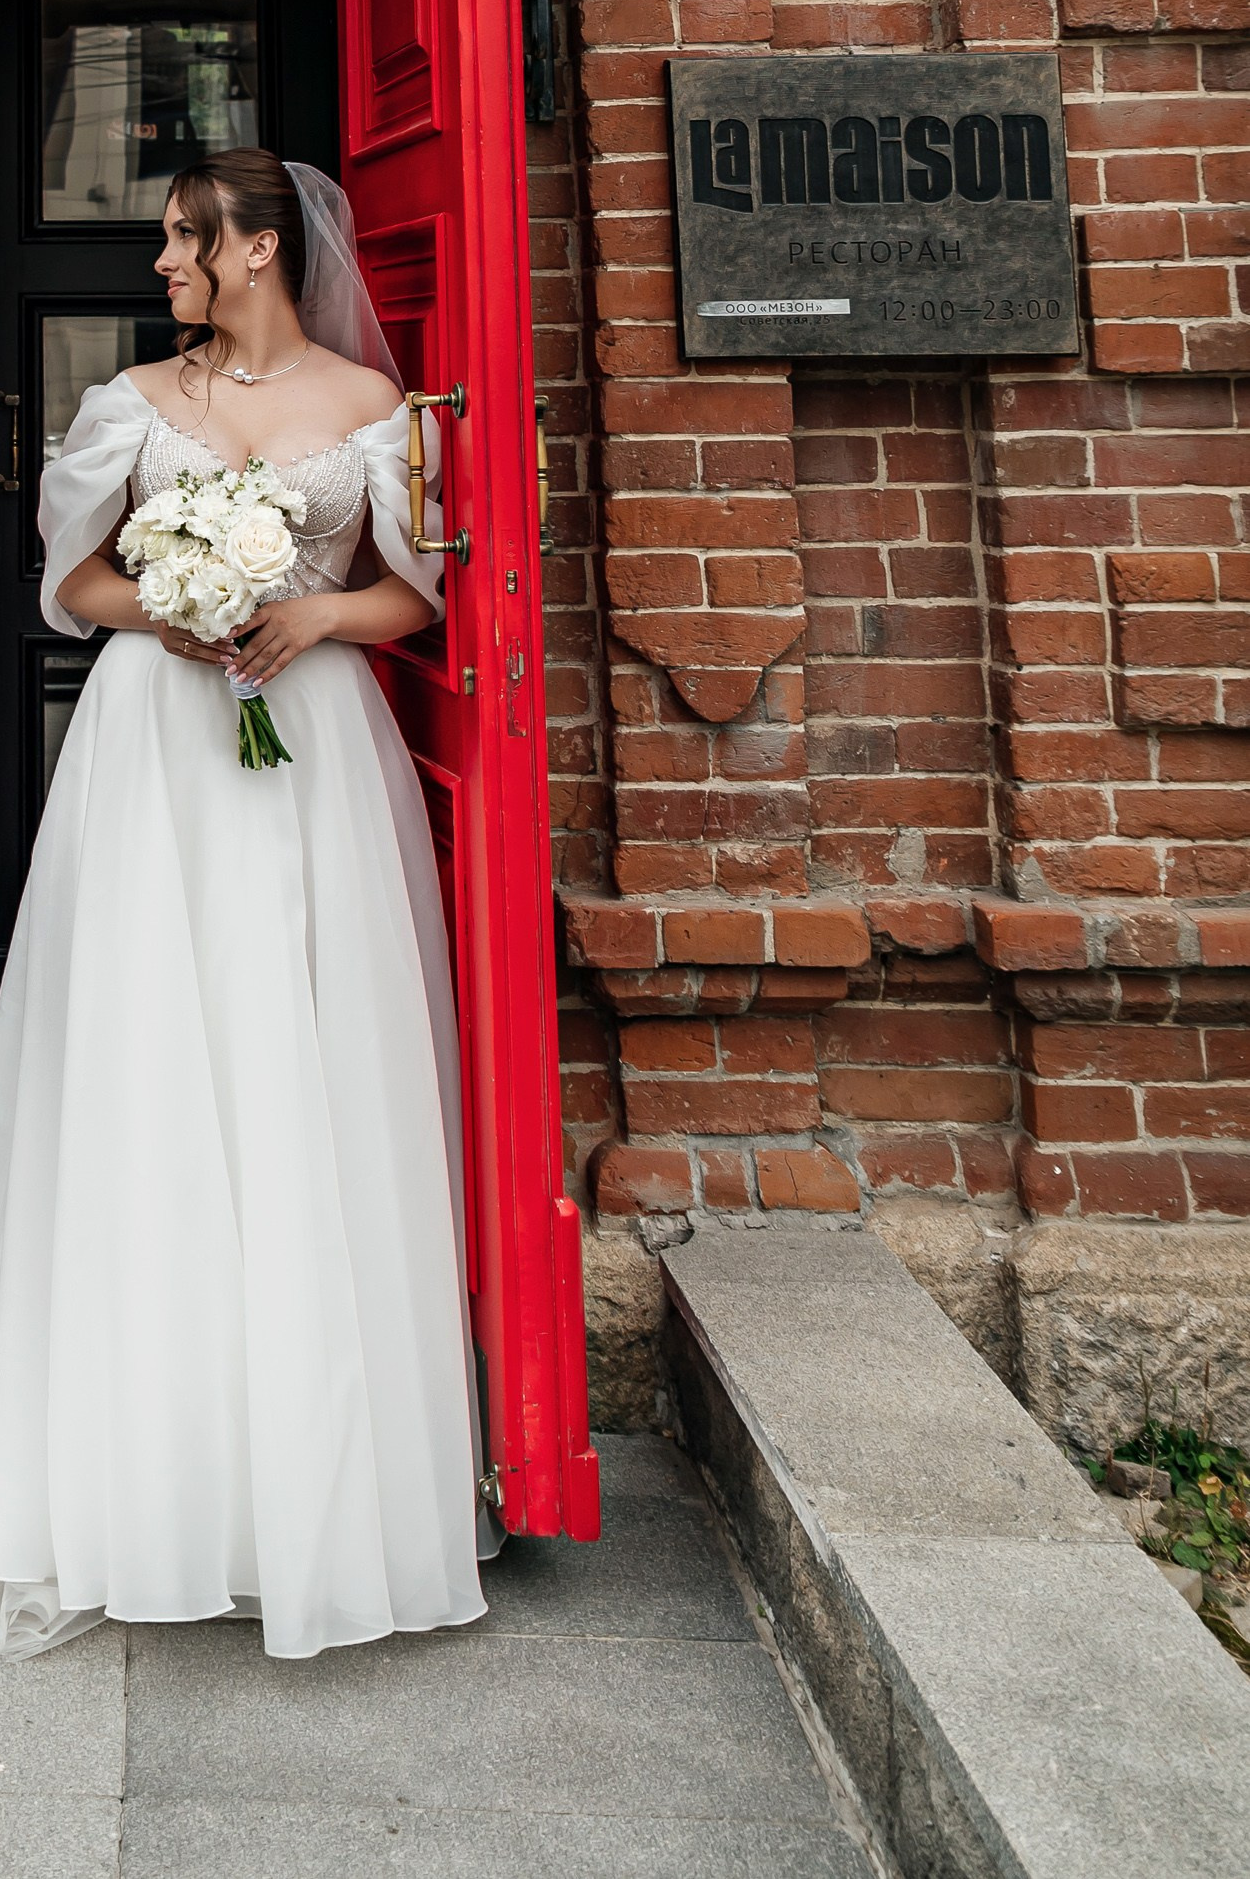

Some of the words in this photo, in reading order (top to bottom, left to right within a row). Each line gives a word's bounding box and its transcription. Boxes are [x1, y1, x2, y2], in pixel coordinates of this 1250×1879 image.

[690, 118, 753, 213] La
[758, 114, 1052, 205] maison
[788, 240, 961, 264] РЕСТОРАН
[725, 303, 757, 314] ООО
[760, 302, 823, 313] «МЕЗОН»
[814, 314, 831, 325] 25
